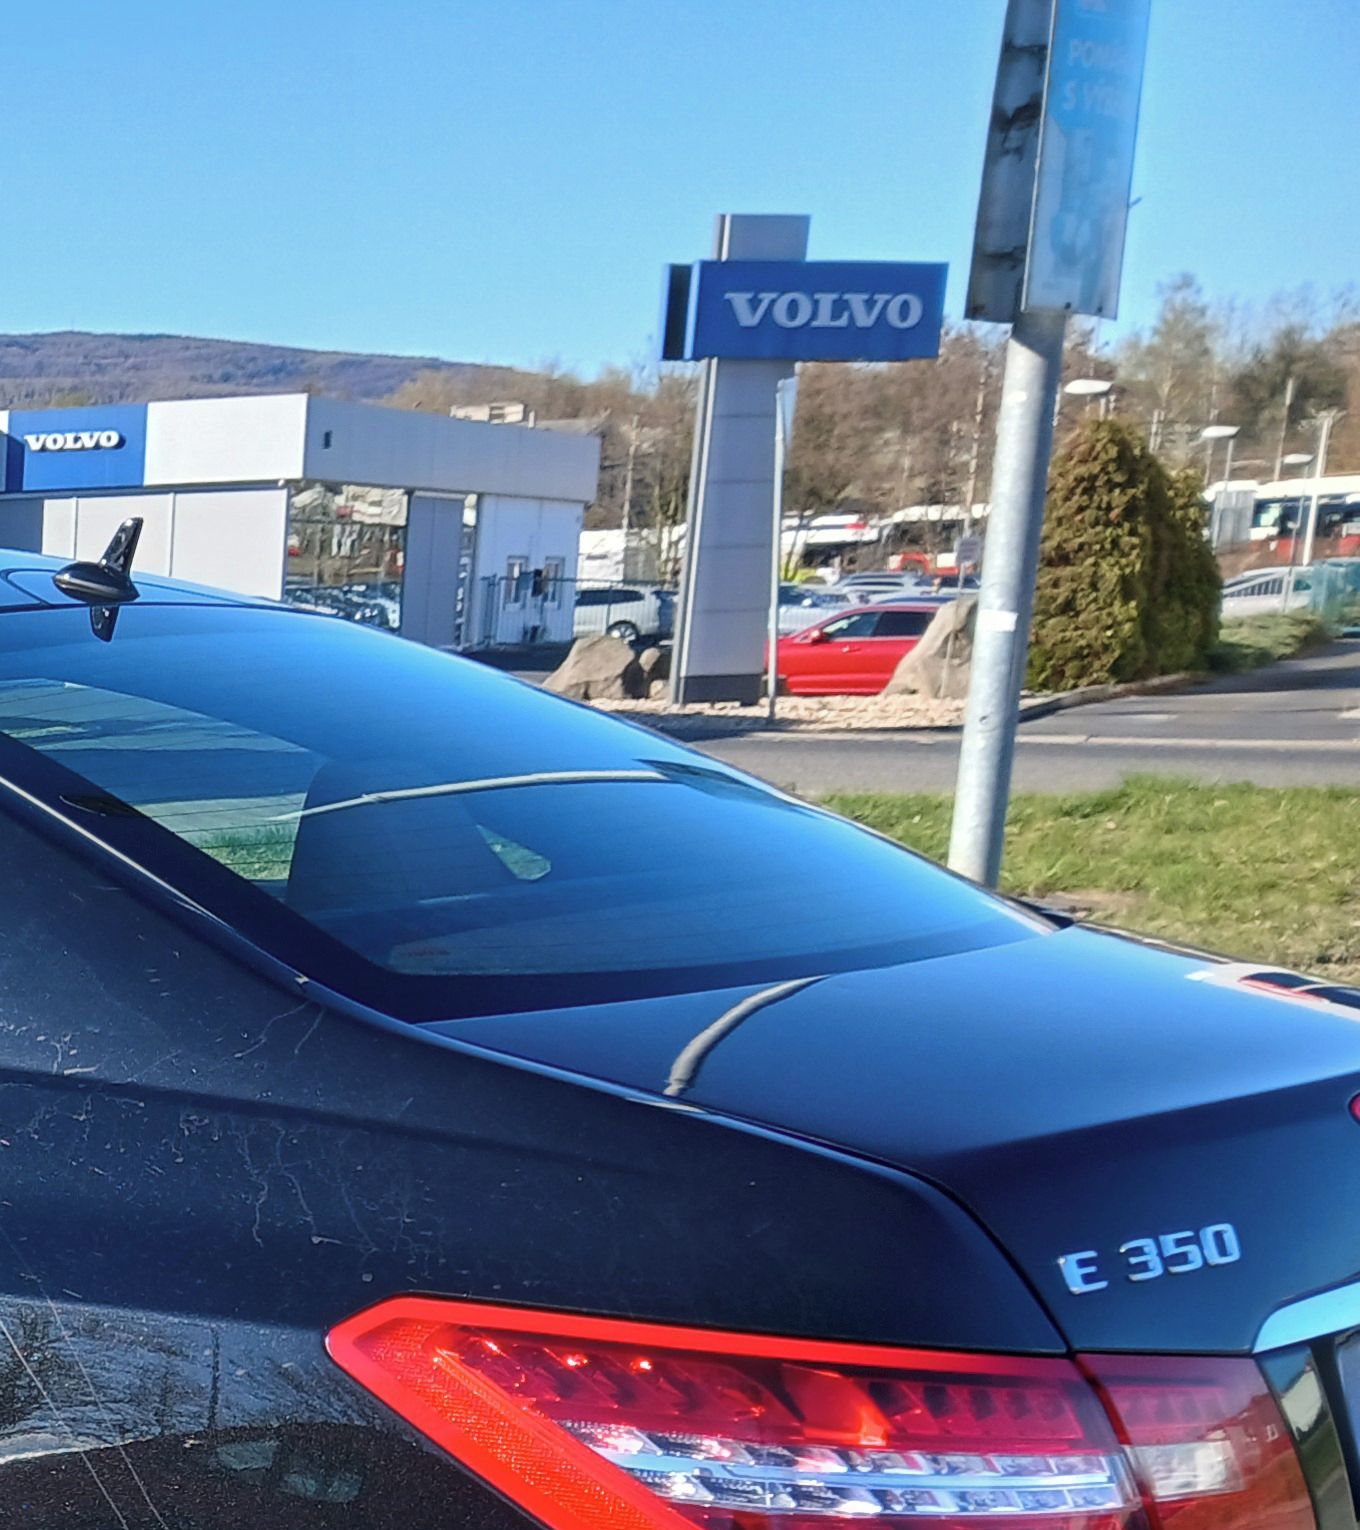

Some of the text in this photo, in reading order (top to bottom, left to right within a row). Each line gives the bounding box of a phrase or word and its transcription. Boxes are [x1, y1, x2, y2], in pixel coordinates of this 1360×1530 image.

[724, 291, 924, 329] VOLVO
[24, 430, 120, 450] VOLVO
[1058, 1223, 1241, 1295] E 350
